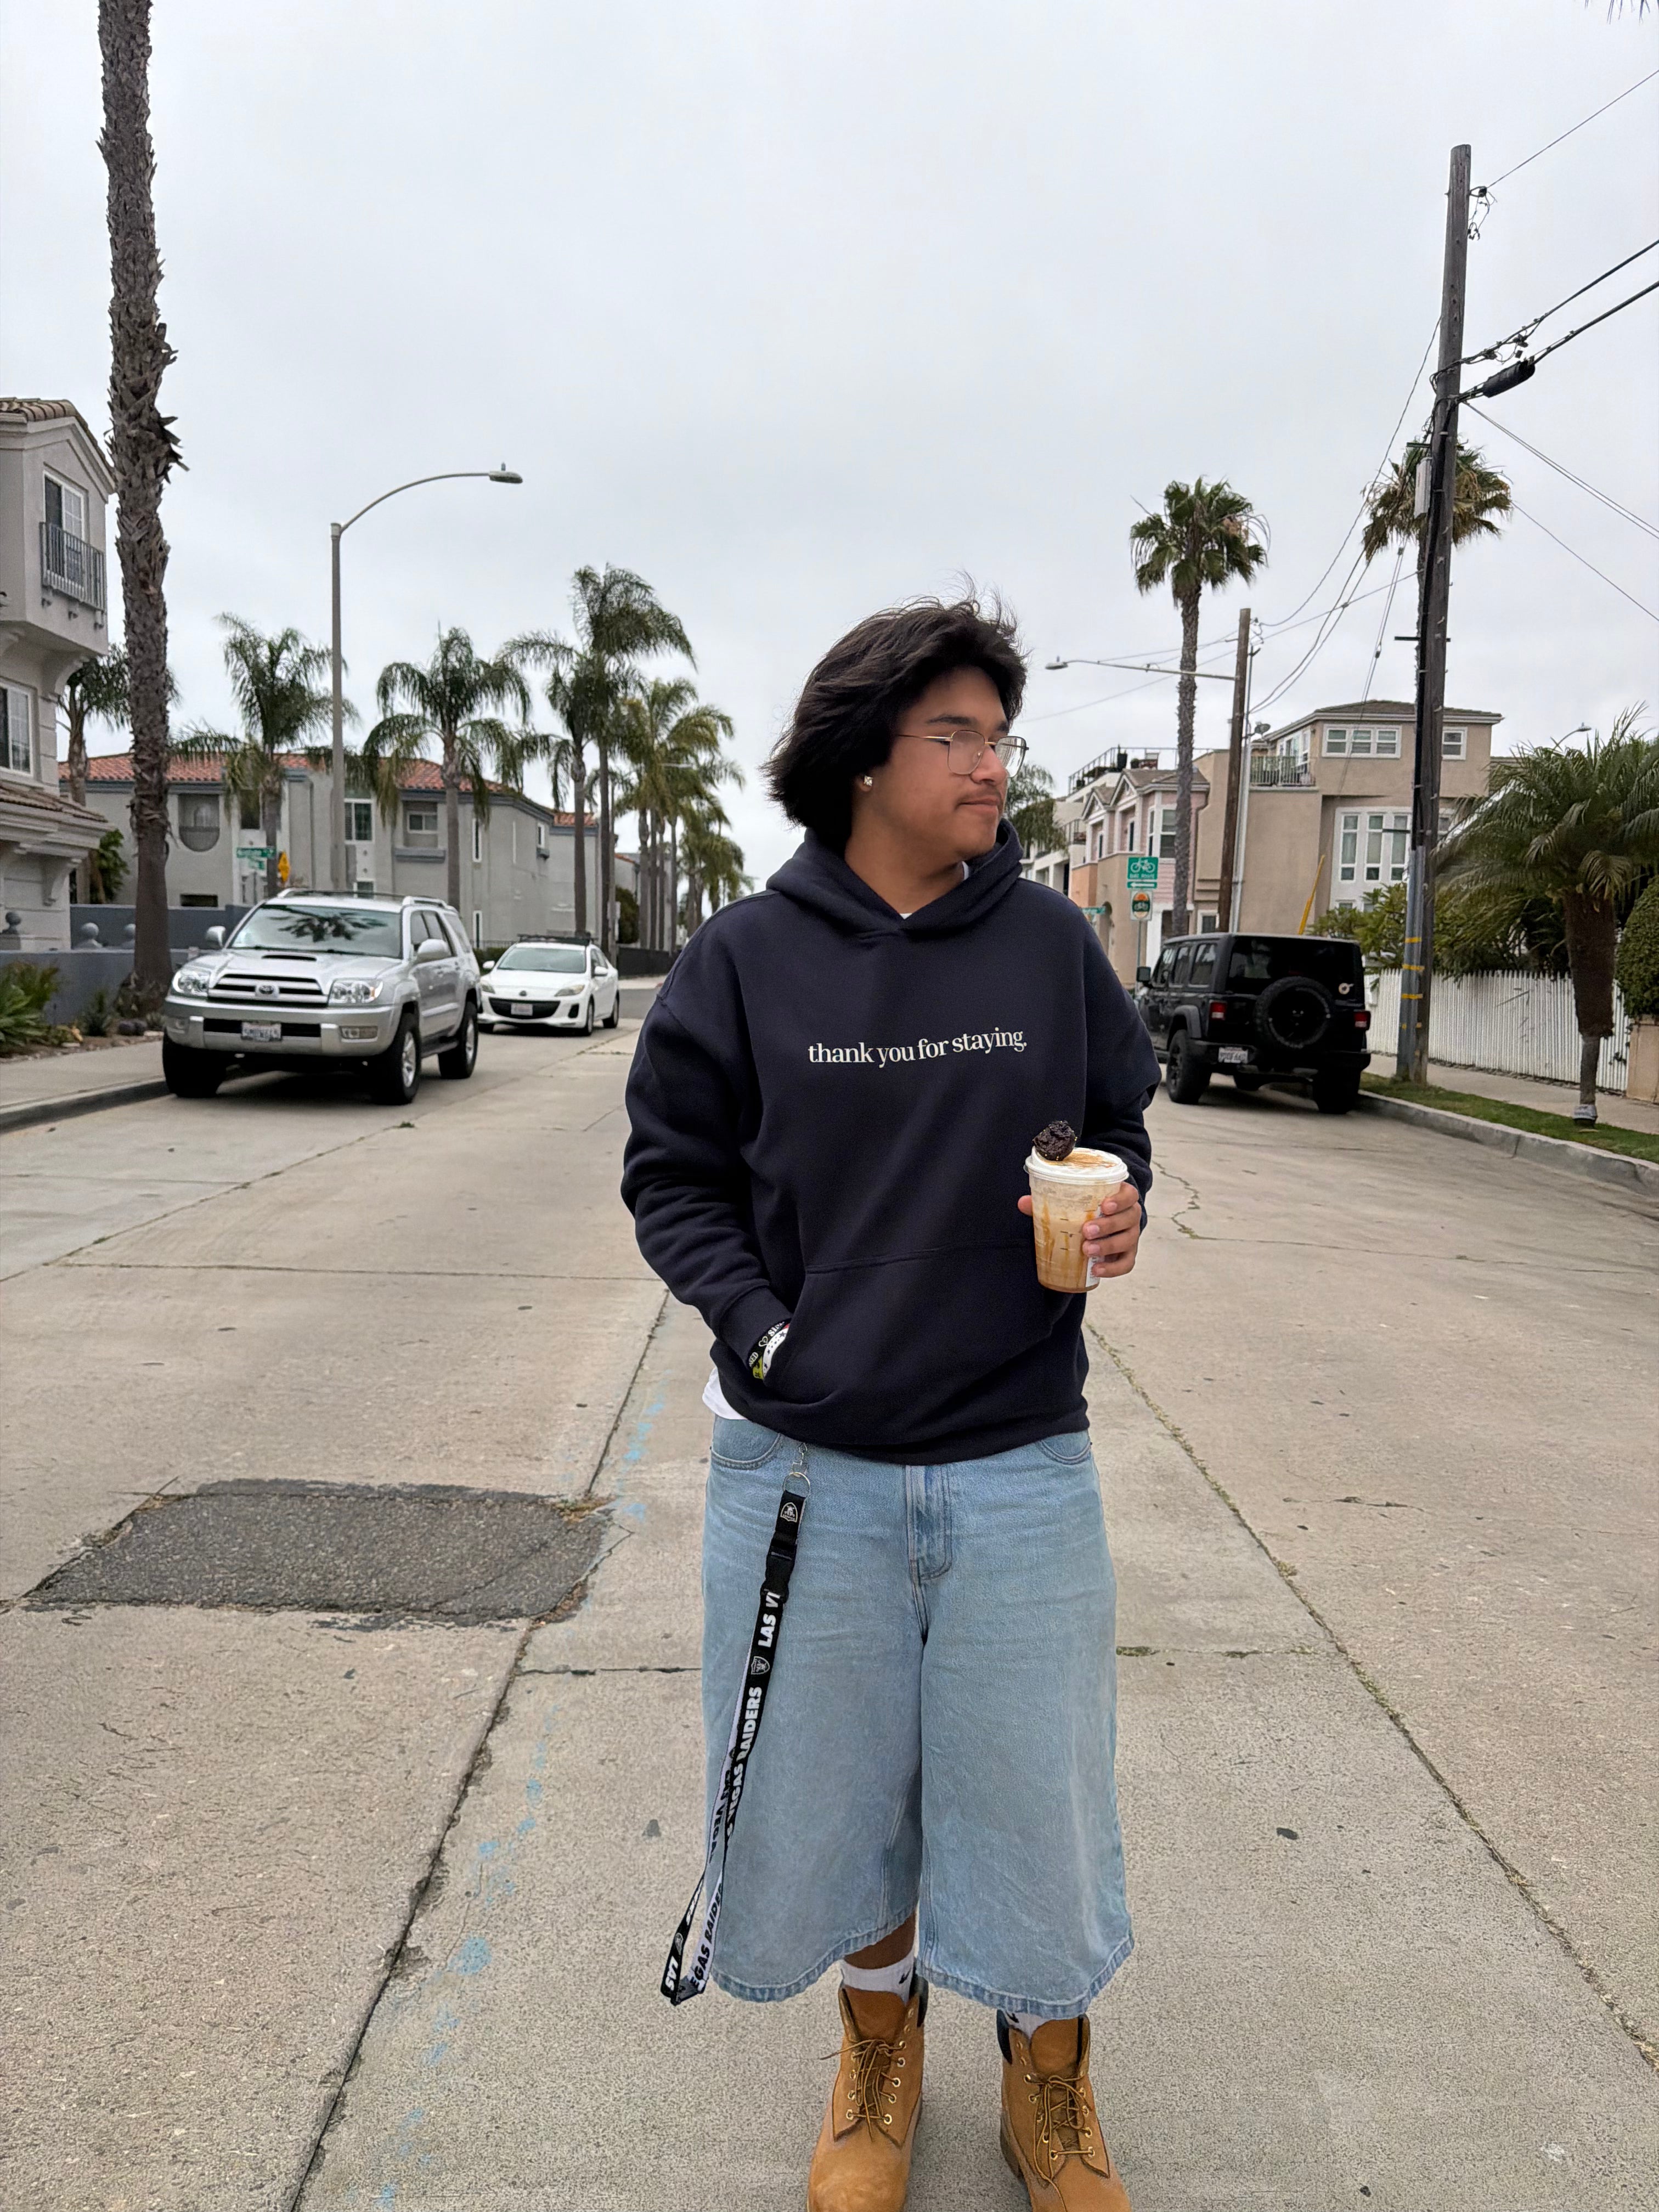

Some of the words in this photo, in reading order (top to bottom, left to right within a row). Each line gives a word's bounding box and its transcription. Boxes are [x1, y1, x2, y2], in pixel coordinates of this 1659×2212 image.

[808, 1042, 875, 1063] thank
[876, 1046, 916, 1068] you
[917, 1038, 950, 1059] for
[951, 1027, 1028, 1054] staying.
[758, 1613, 777, 1648] LAS
[736, 1686, 762, 1762] RAIDERS
[665, 1955, 678, 1991] LAS
